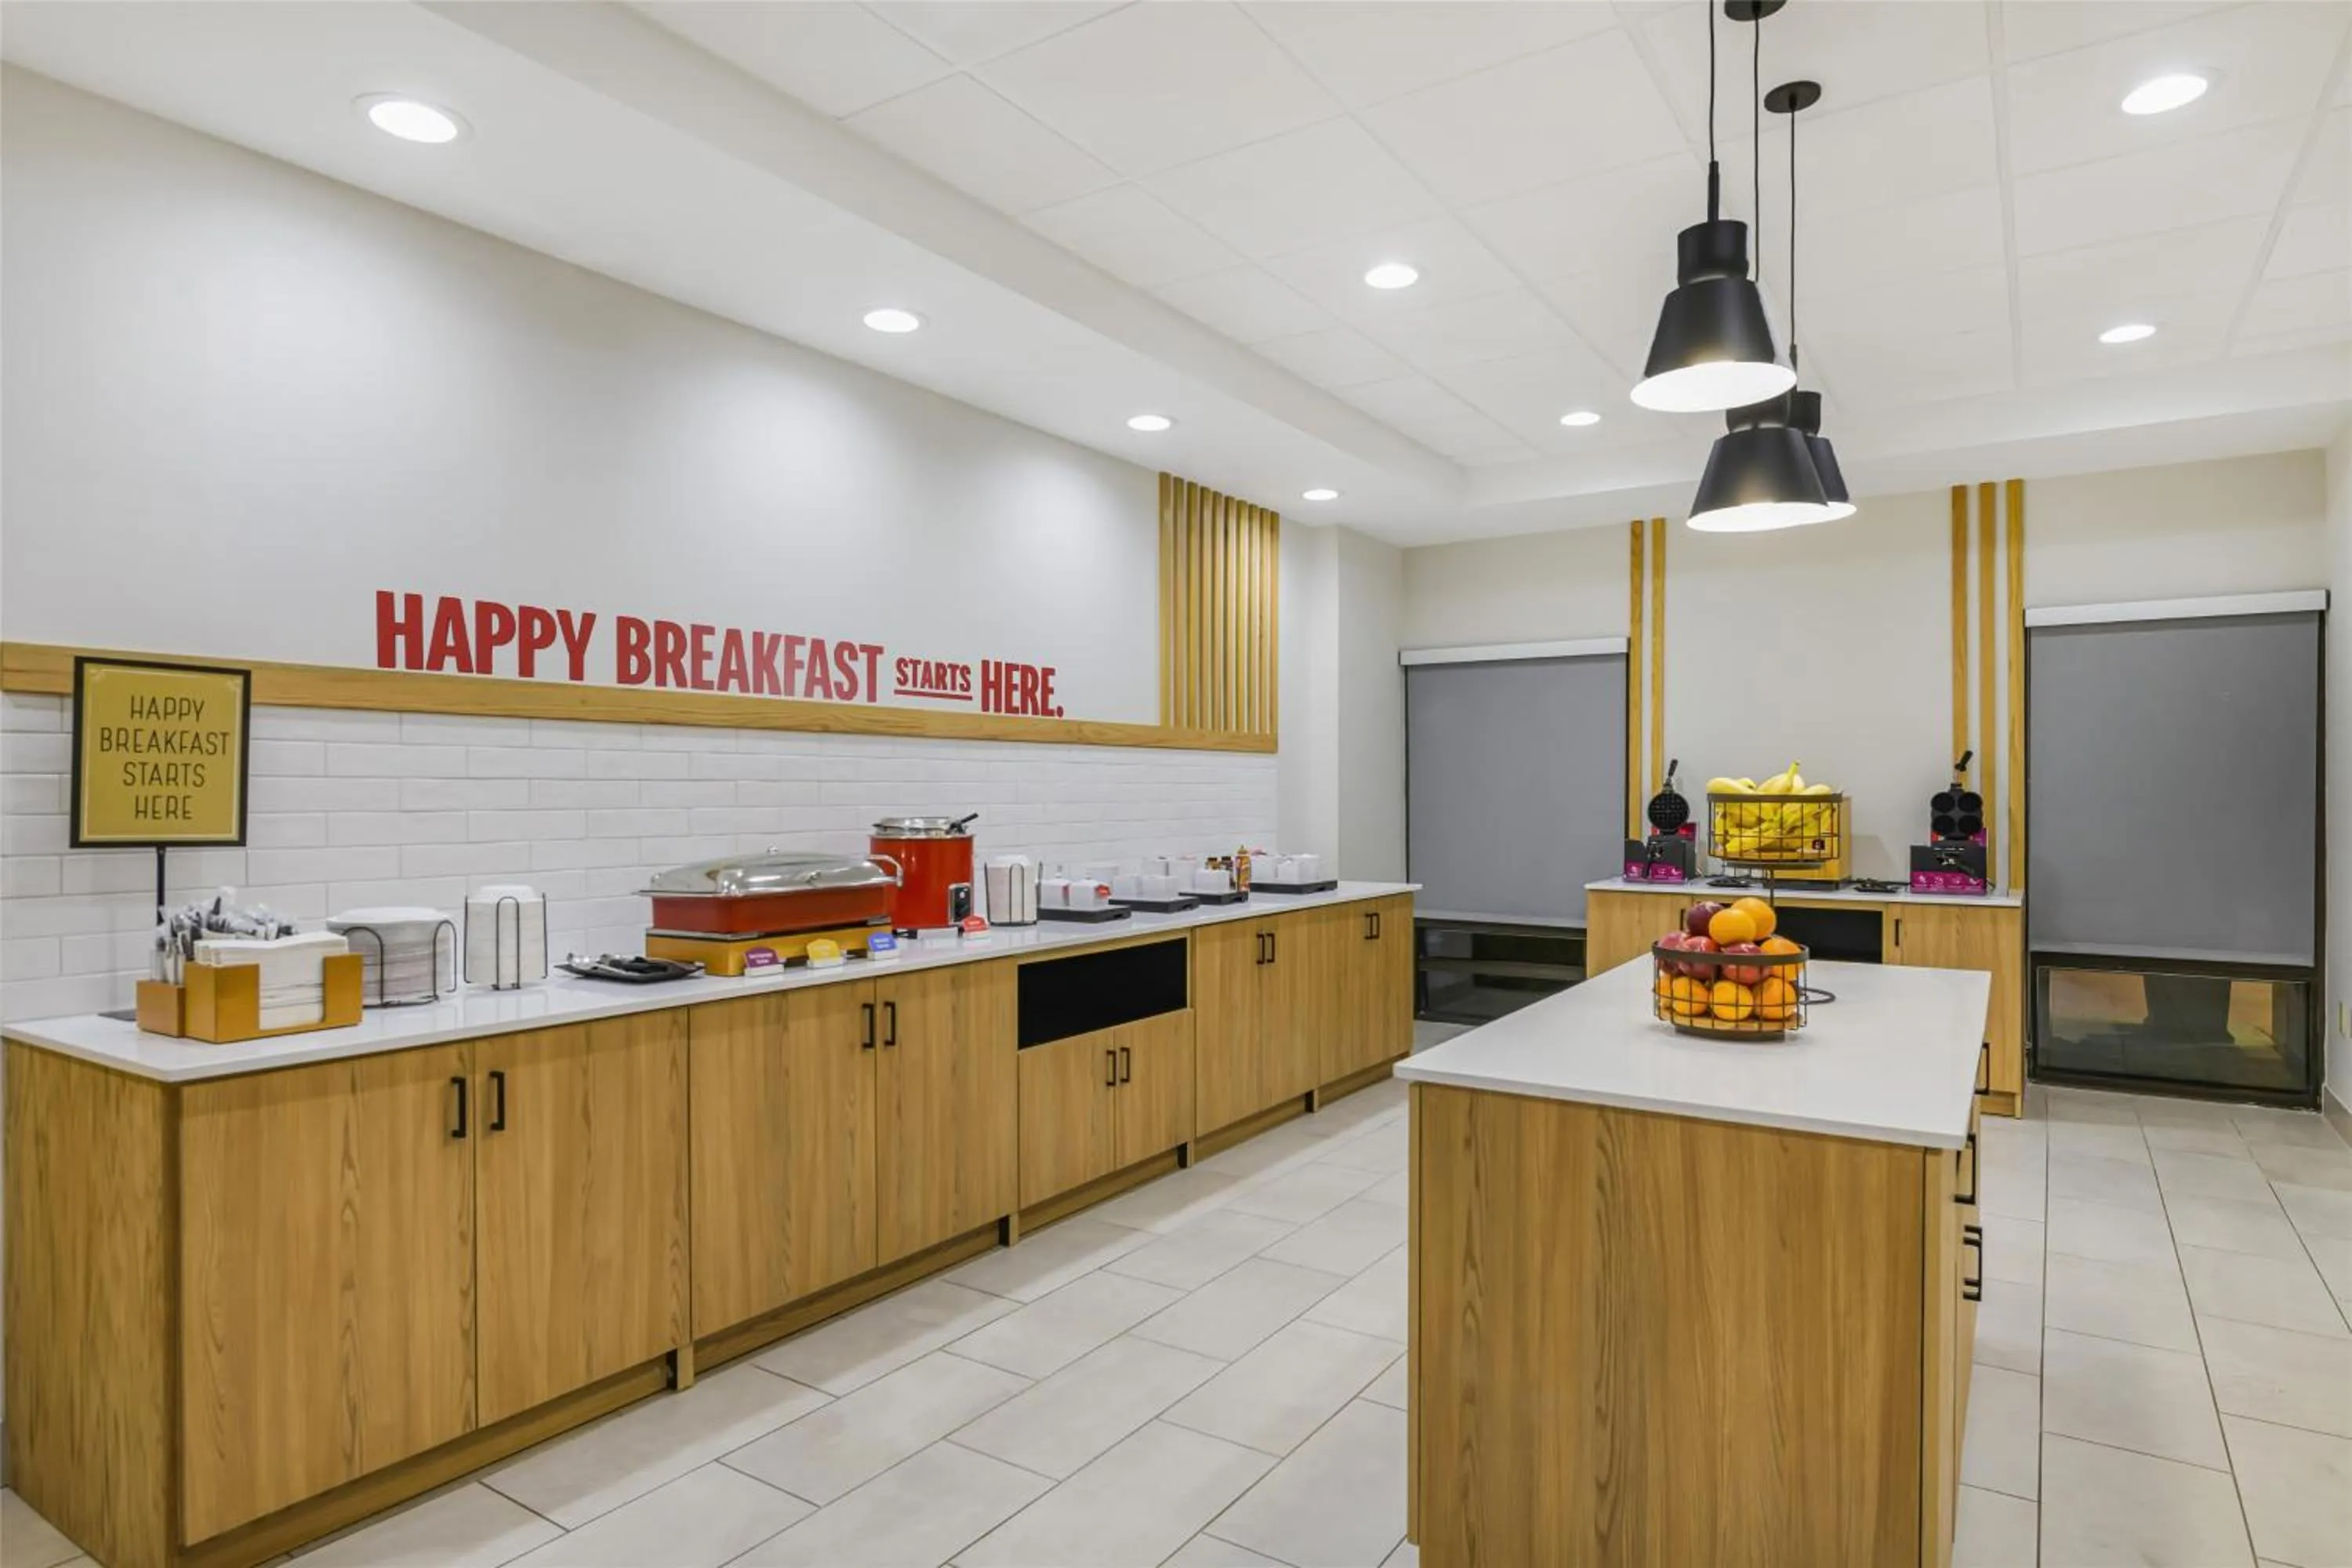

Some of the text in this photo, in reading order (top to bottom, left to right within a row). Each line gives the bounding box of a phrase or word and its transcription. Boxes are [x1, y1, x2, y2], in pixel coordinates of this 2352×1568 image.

[376, 590, 1064, 717] HAPPY BREAKFAST STARTS HERE.
[129, 694, 205, 723] HAPPY
[99, 727, 231, 756] BREAKFAST
[122, 760, 206, 788] STARTS
[134, 794, 194, 820] HERE
